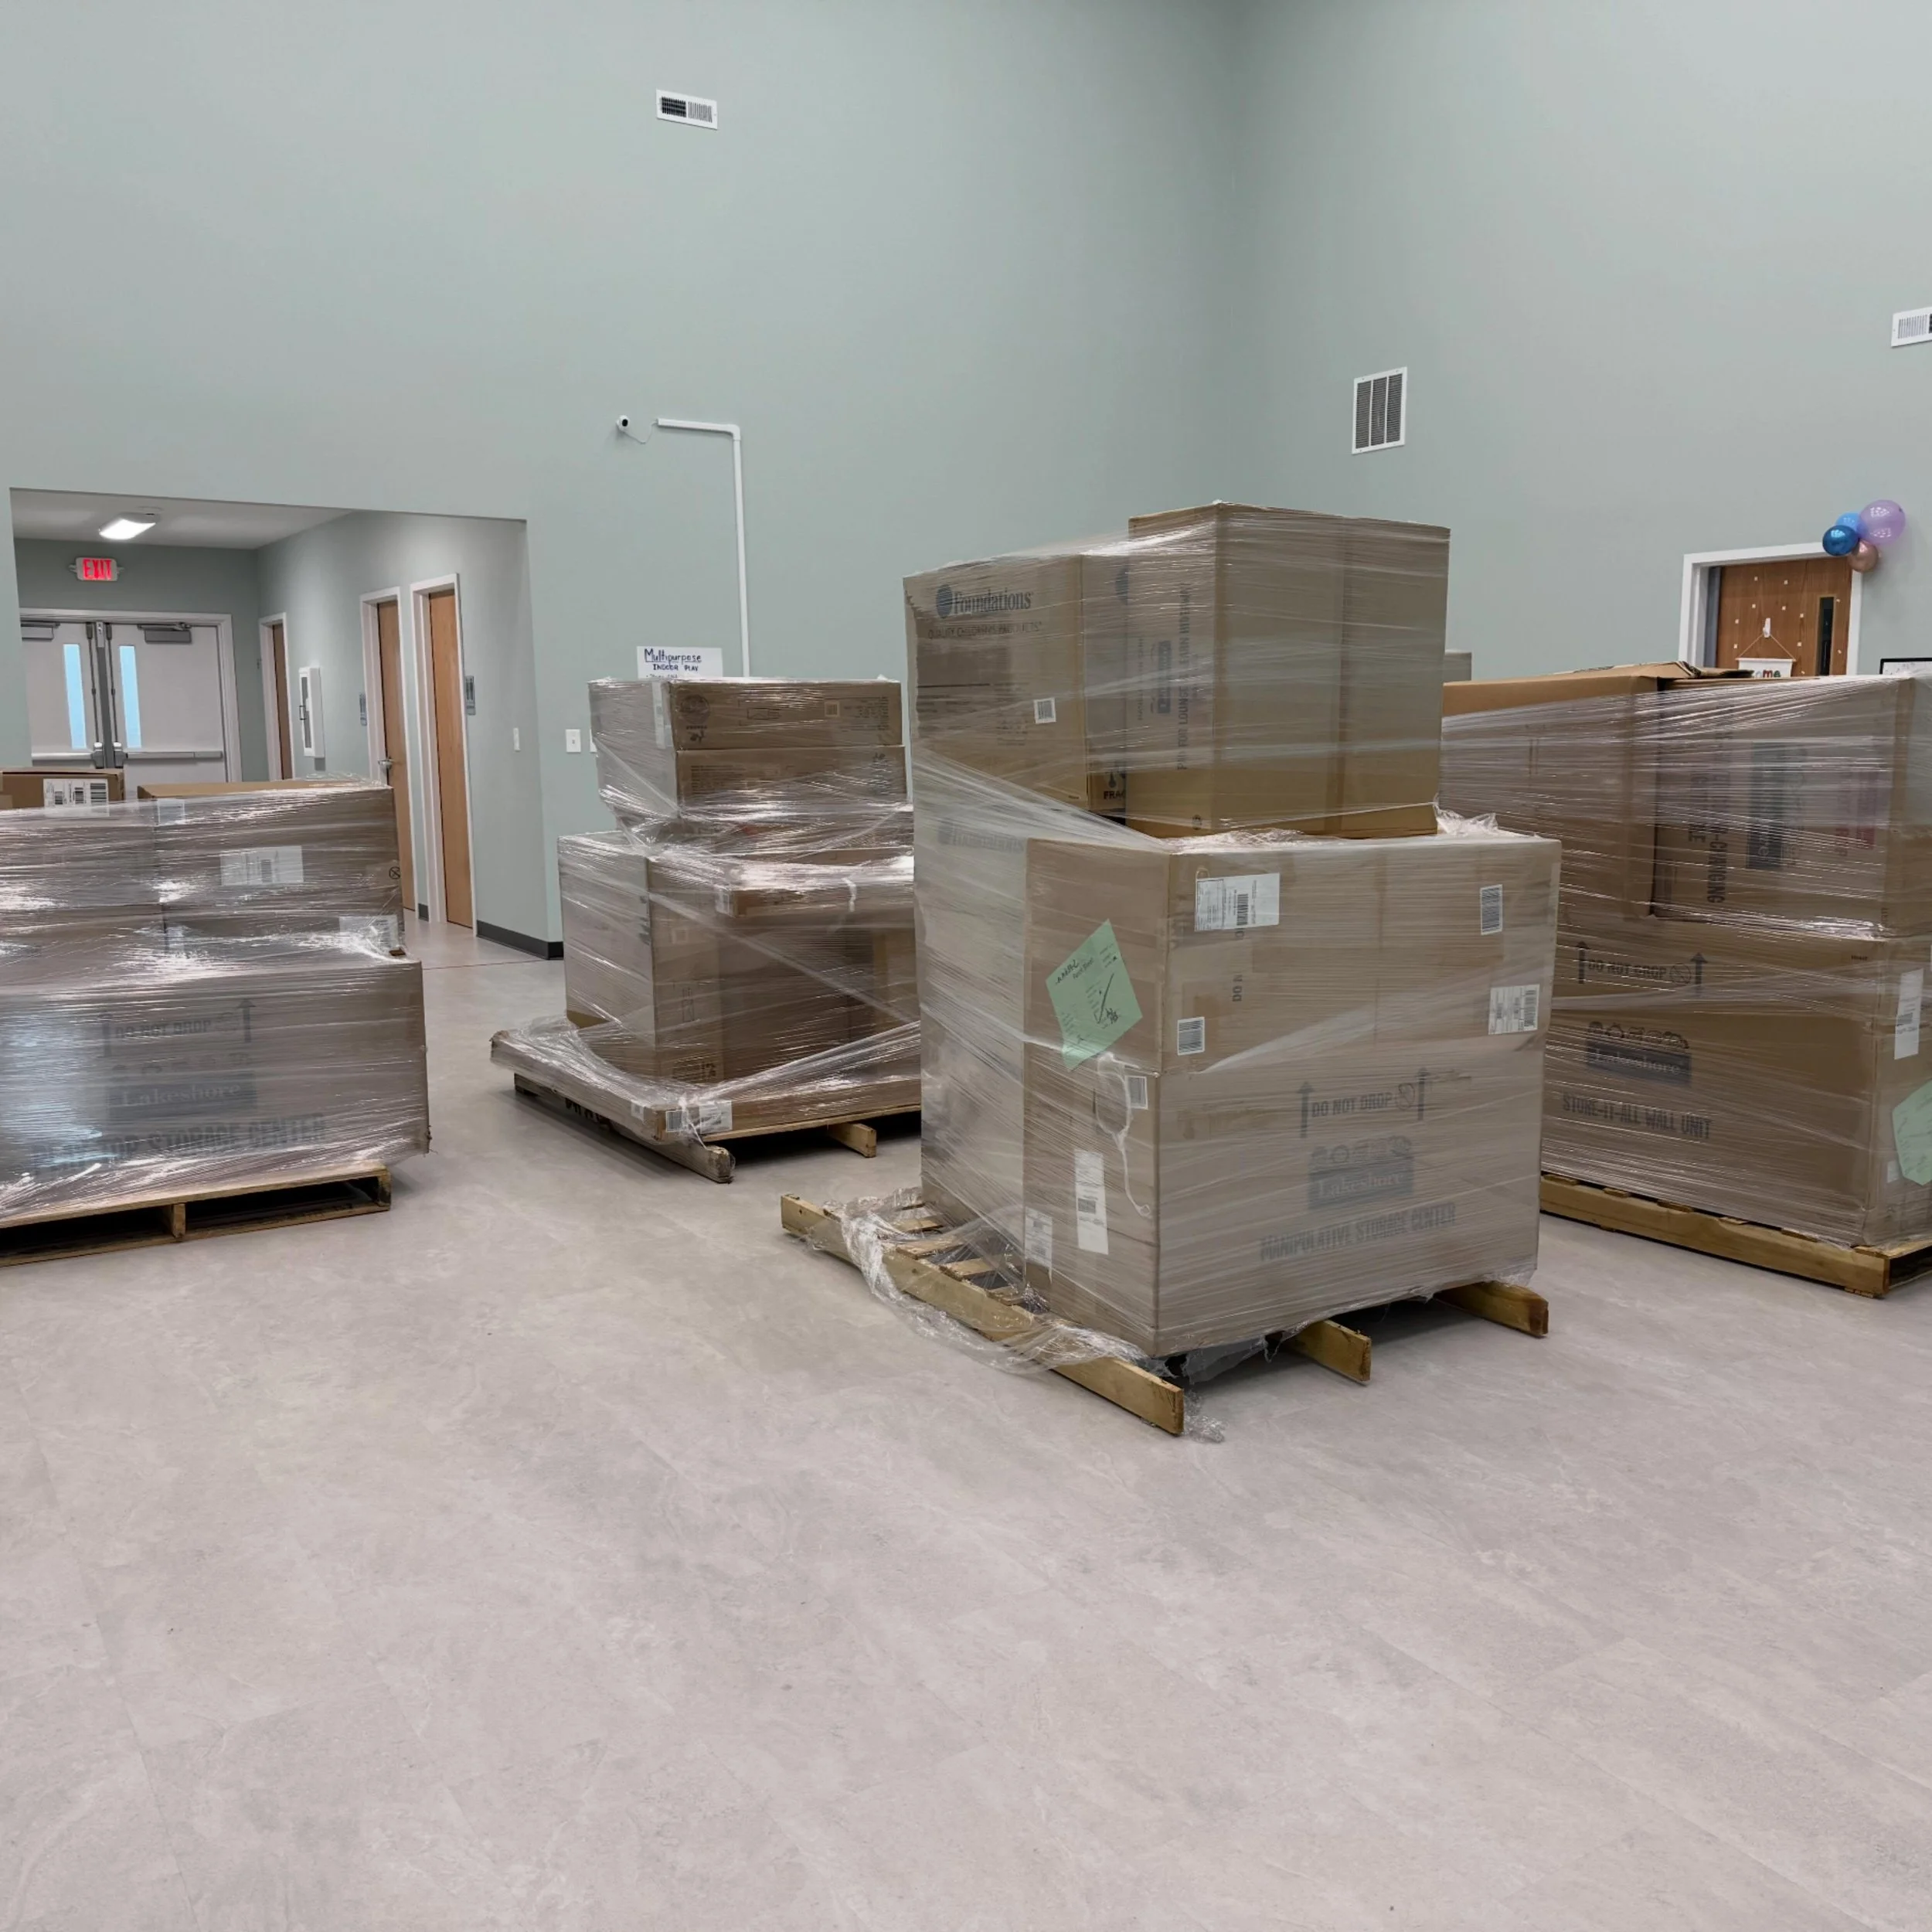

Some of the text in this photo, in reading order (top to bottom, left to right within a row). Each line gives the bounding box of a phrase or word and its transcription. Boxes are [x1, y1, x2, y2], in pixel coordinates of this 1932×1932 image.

[83, 558, 112, 580] EXIT
[954, 588, 1032, 614] Foundations
[645, 648, 702, 665] Multipurpose
[1178, 729, 1189, 747] FOR
[122, 1083, 241, 1106] Lakeshore
[1311, 1092, 1393, 1117] DO NOT DROP
[1645, 1107, 1676, 1131] WALL
[1681, 1114, 1713, 1140] UNIT
[1318, 1173, 1402, 1199] Lakeshore
